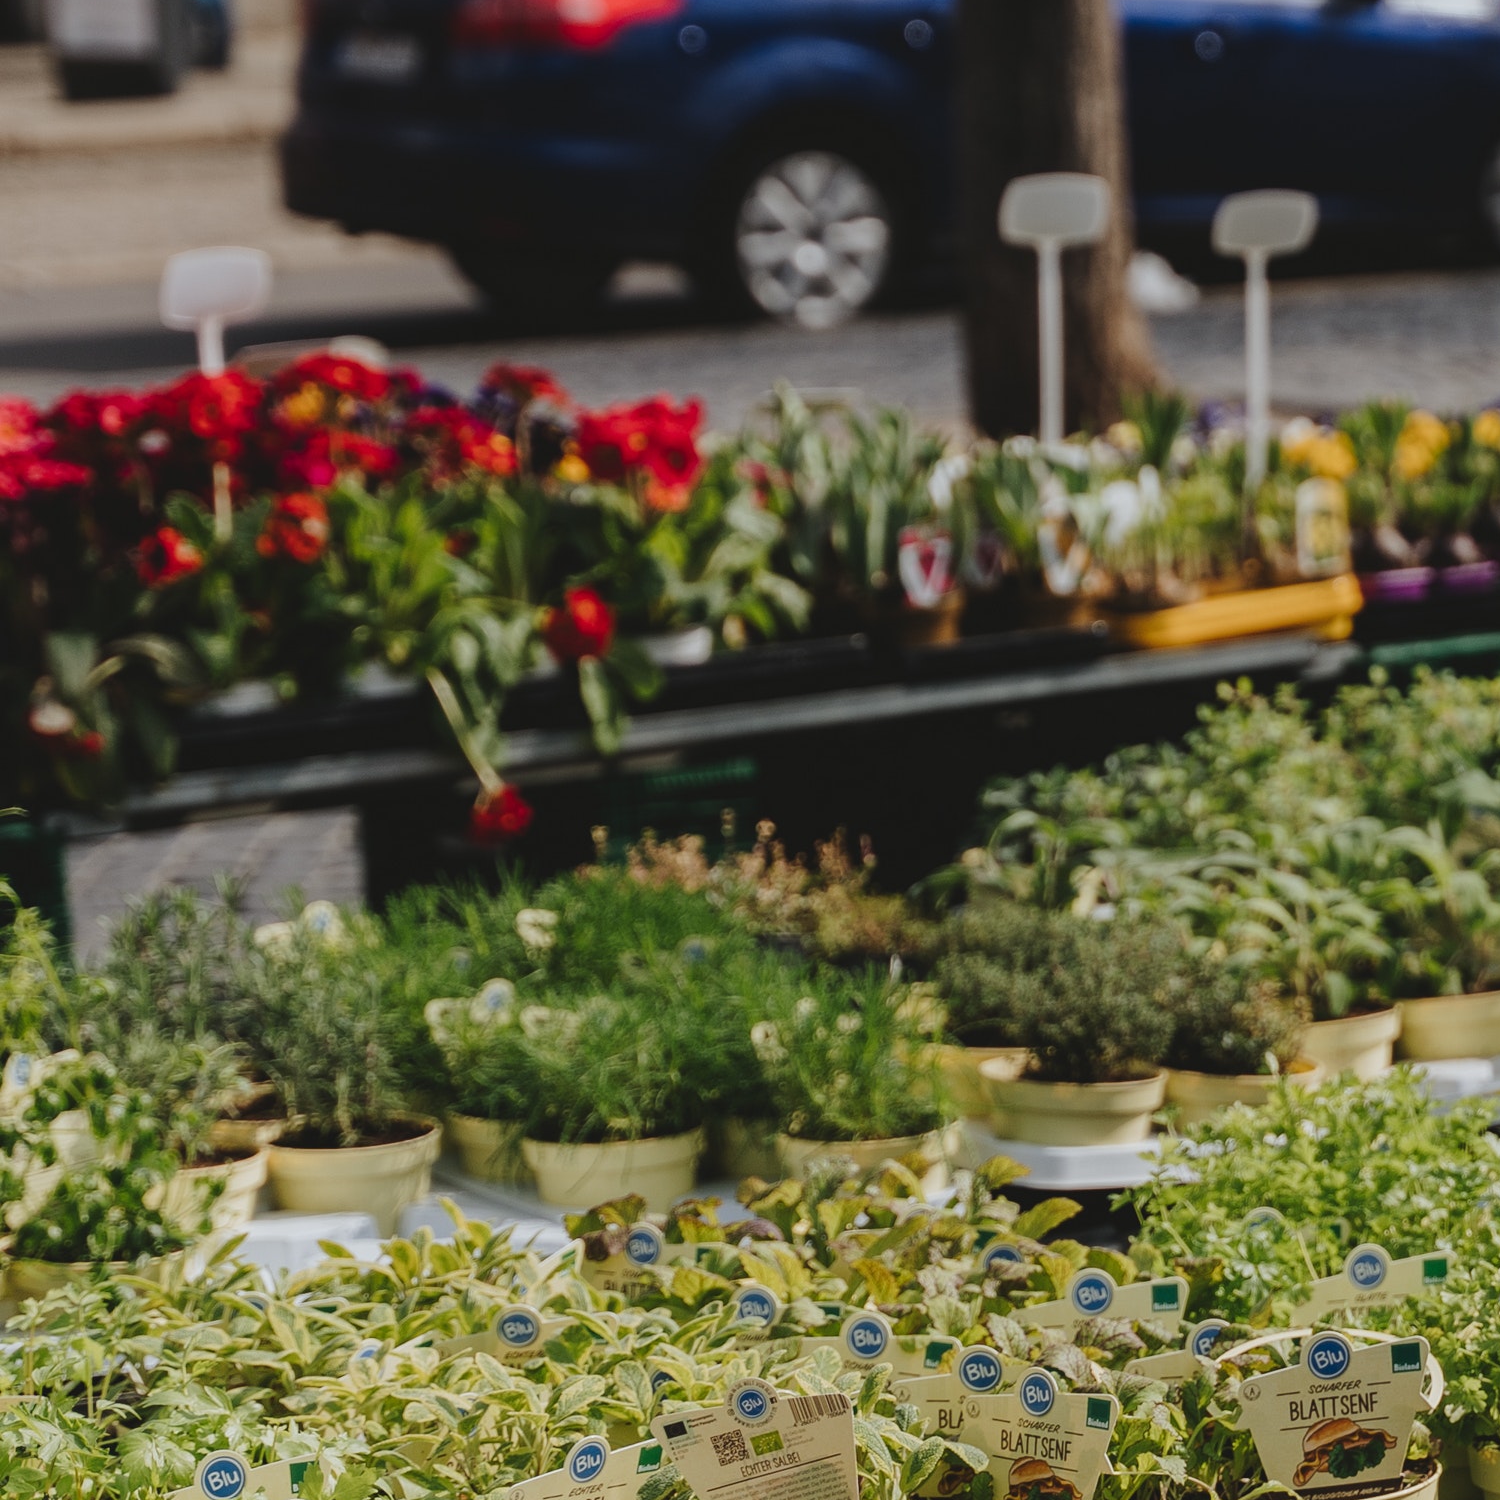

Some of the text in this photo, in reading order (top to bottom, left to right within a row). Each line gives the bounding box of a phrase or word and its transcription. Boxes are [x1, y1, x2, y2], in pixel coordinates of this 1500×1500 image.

[1353, 1261, 1381, 1281] Blu
[1078, 1286, 1107, 1306] Blu
[853, 1329, 883, 1347] Blu
[1314, 1350, 1344, 1369] Blu
[1393, 1362, 1420, 1372] Bioland
[966, 1361, 996, 1382] Blu
[1026, 1386, 1050, 1404] Blu
[1308, 1380, 1361, 1394] SCHARFER
[741, 1398, 763, 1412] Blu
[1289, 1392, 1378, 1421] BLATTSENF
[1017, 1418, 1061, 1434] SCHARFER
[1001, 1429, 1072, 1462] BLATTSENF
[575, 1452, 601, 1474] Blu
[740, 1452, 801, 1477] ECHTER SALBEI
[207, 1470, 240, 1492] Blu
[568, 1484, 603, 1498] ECHTER
